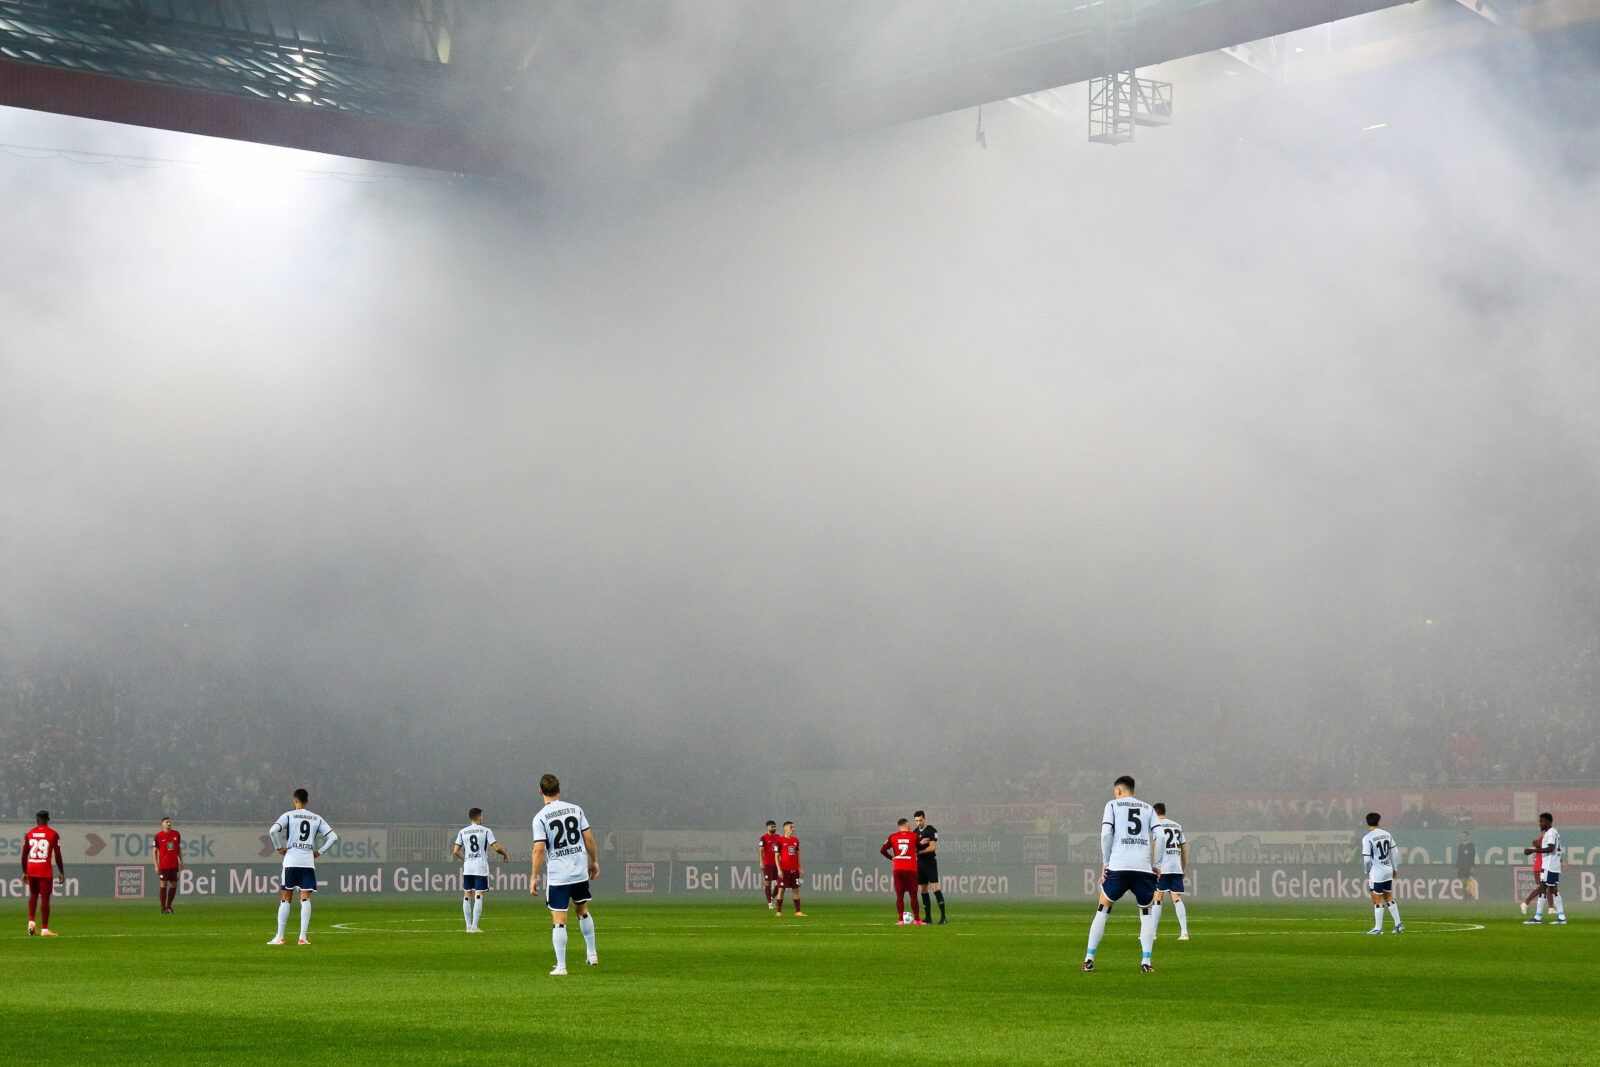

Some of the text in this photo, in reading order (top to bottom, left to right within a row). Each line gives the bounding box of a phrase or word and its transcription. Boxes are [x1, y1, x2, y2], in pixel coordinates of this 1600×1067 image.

[299, 820, 310, 841] 9
[1128, 808, 1141, 835] 5
[549, 816, 580, 849] 28
[1164, 829, 1181, 848] 23
[29, 838, 49, 859] 29
[470, 835, 479, 852] 8
[898, 843, 908, 856] 7
[1376, 840, 1390, 860] 10
[179, 869, 216, 894] Bei
[340, 868, 382, 893] und
[686, 866, 719, 890] Bei
[812, 867, 843, 891] und
[1221, 870, 1260, 897] und
